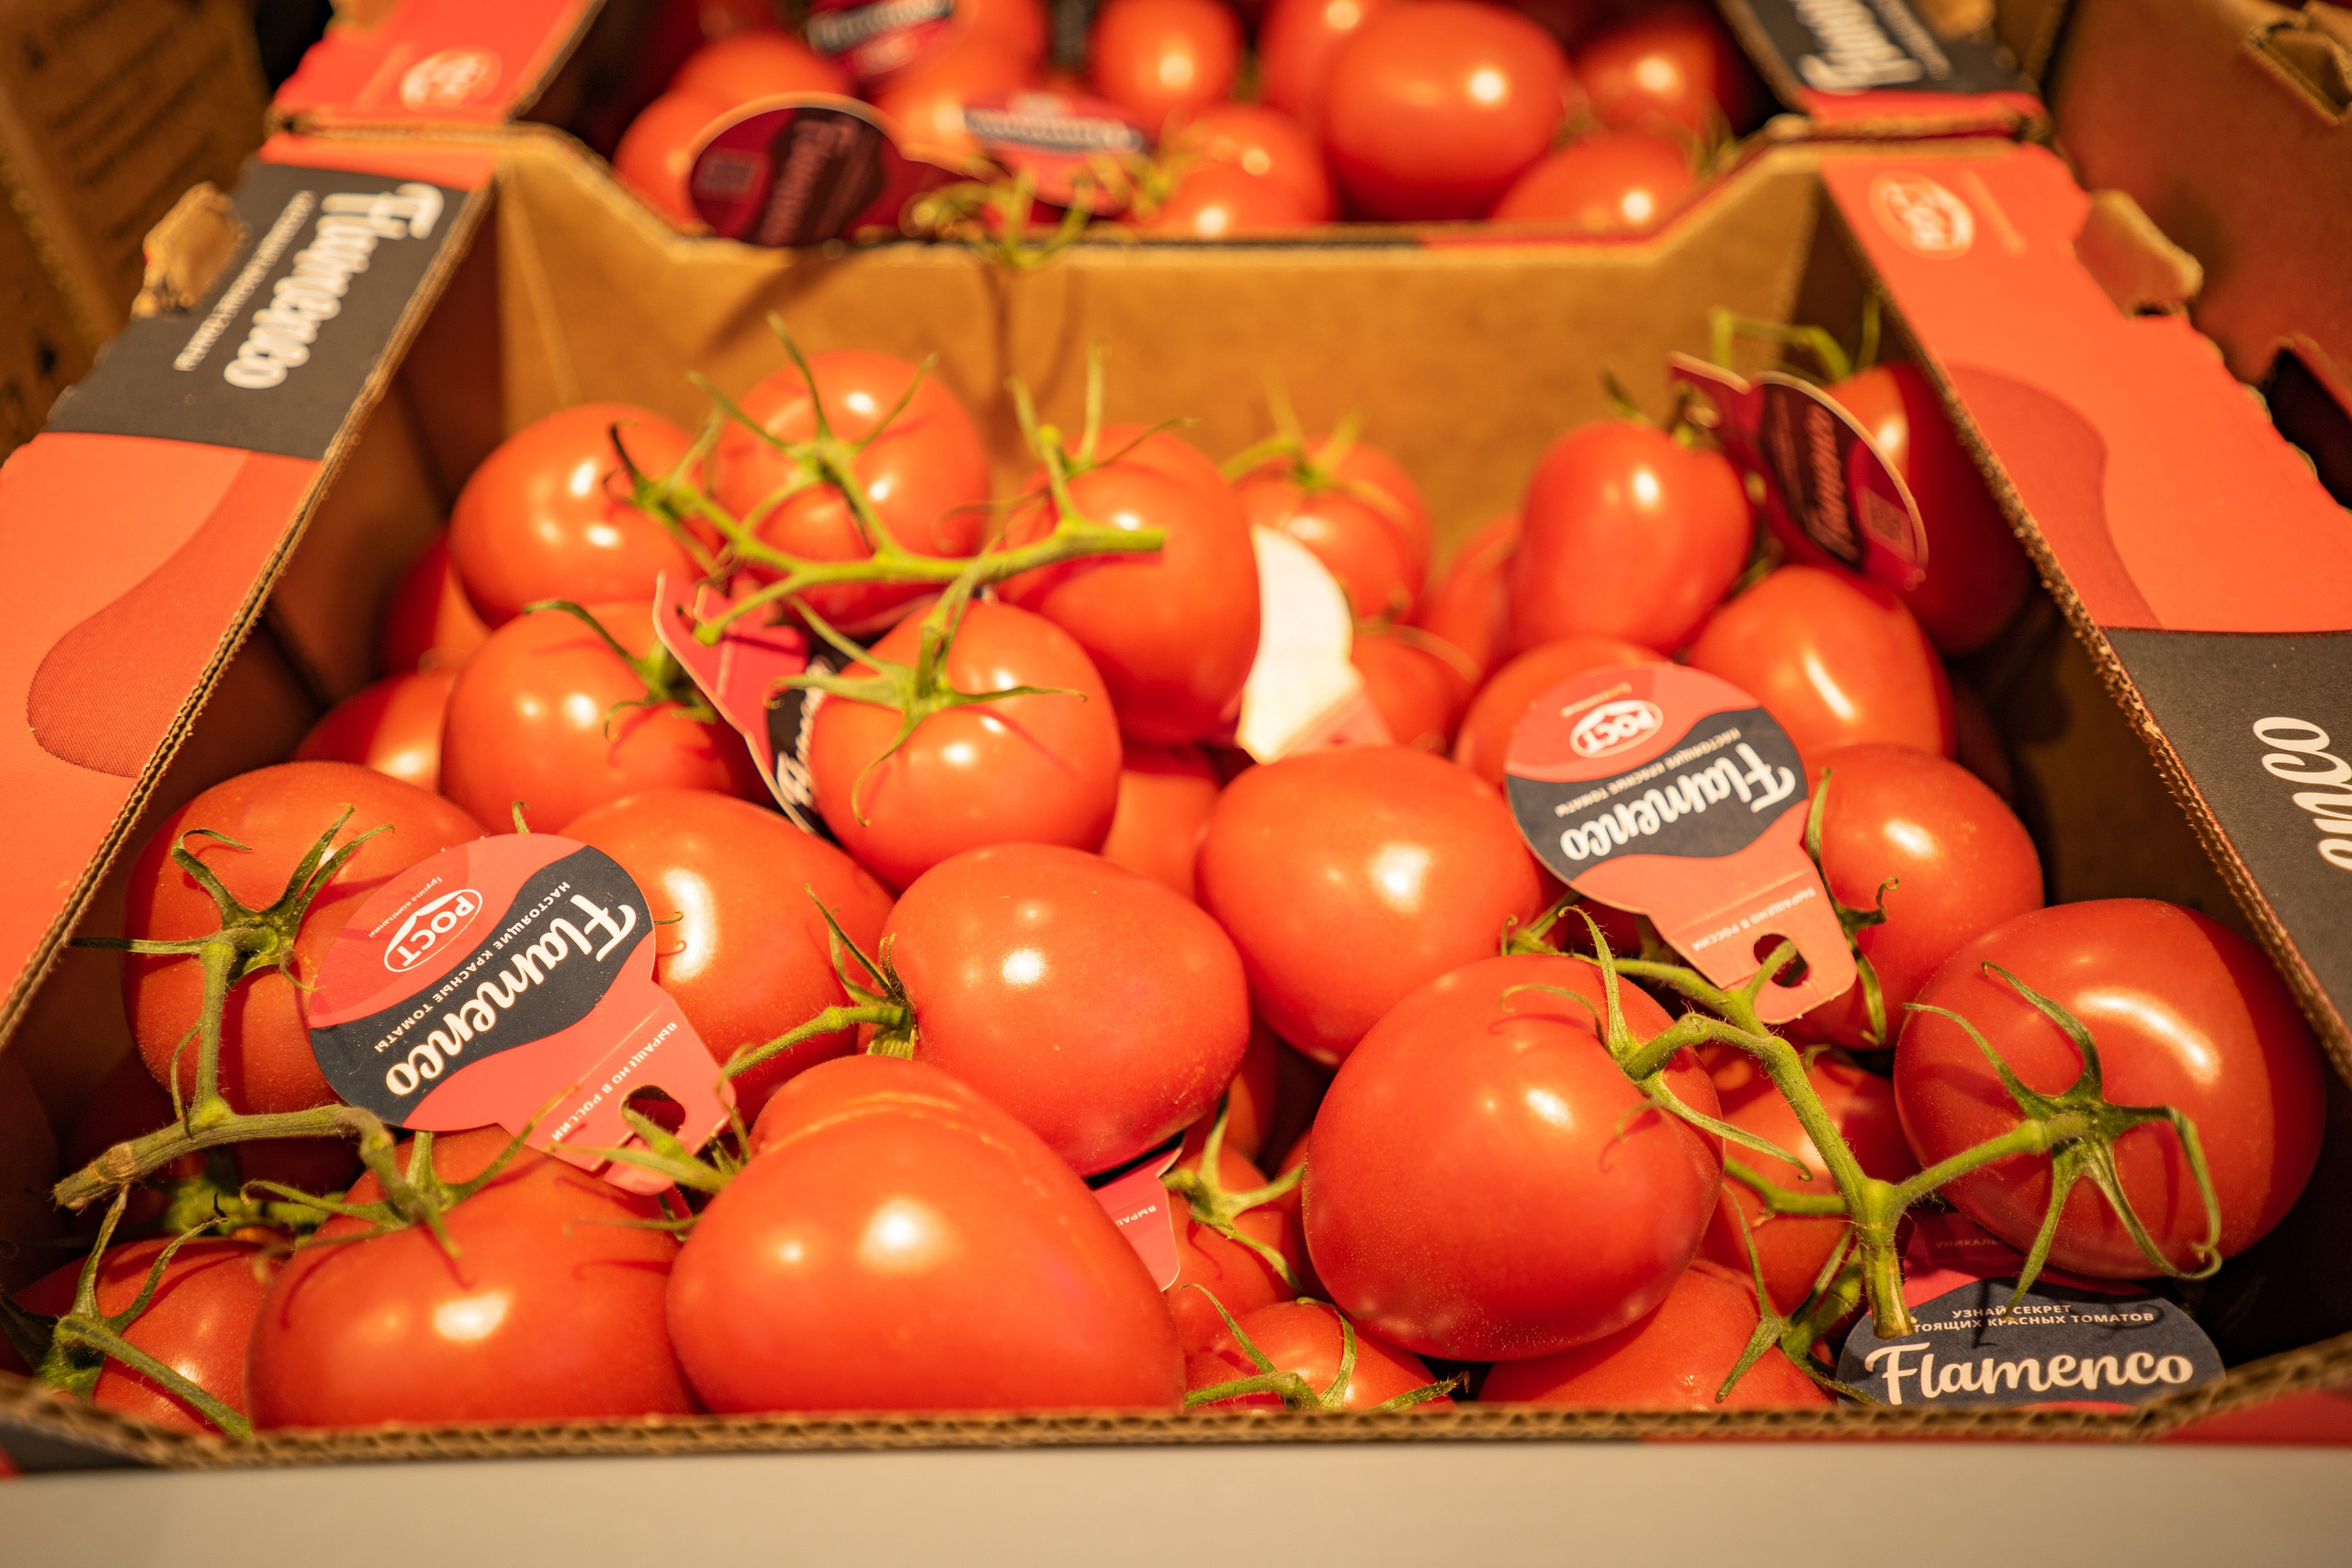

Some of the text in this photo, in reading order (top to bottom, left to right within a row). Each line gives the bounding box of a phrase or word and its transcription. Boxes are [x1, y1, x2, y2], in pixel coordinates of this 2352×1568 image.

[1582, 707, 1656, 752] РОСТ
[1607, 761, 1667, 795] КРАСНЫЕ
[1555, 786, 1610, 818] ТОМАТЫ
[1560, 743, 1796, 861] Flamenco
[396, 895, 476, 967] РОСТ
[1691, 923, 1740, 952] РОССИИ
[374, 881, 571, 1054] НАСТОЯЩИЕ КРАСНЫЕ ТОМАТЫ
[385, 893, 638, 1096] Flamenco
[551, 1021, 678, 1141] ВЫРАЩЕНО В РОССИИ
[1935, 1237, 2000, 1249] УНИКАЛЬ
[1951, 1304, 2071, 1319] УЗНАЙ СЕКРЕТ
[2071, 1313, 2155, 1324] ТОМАТОВ
[1864, 1341, 2194, 1405] Flamenco
